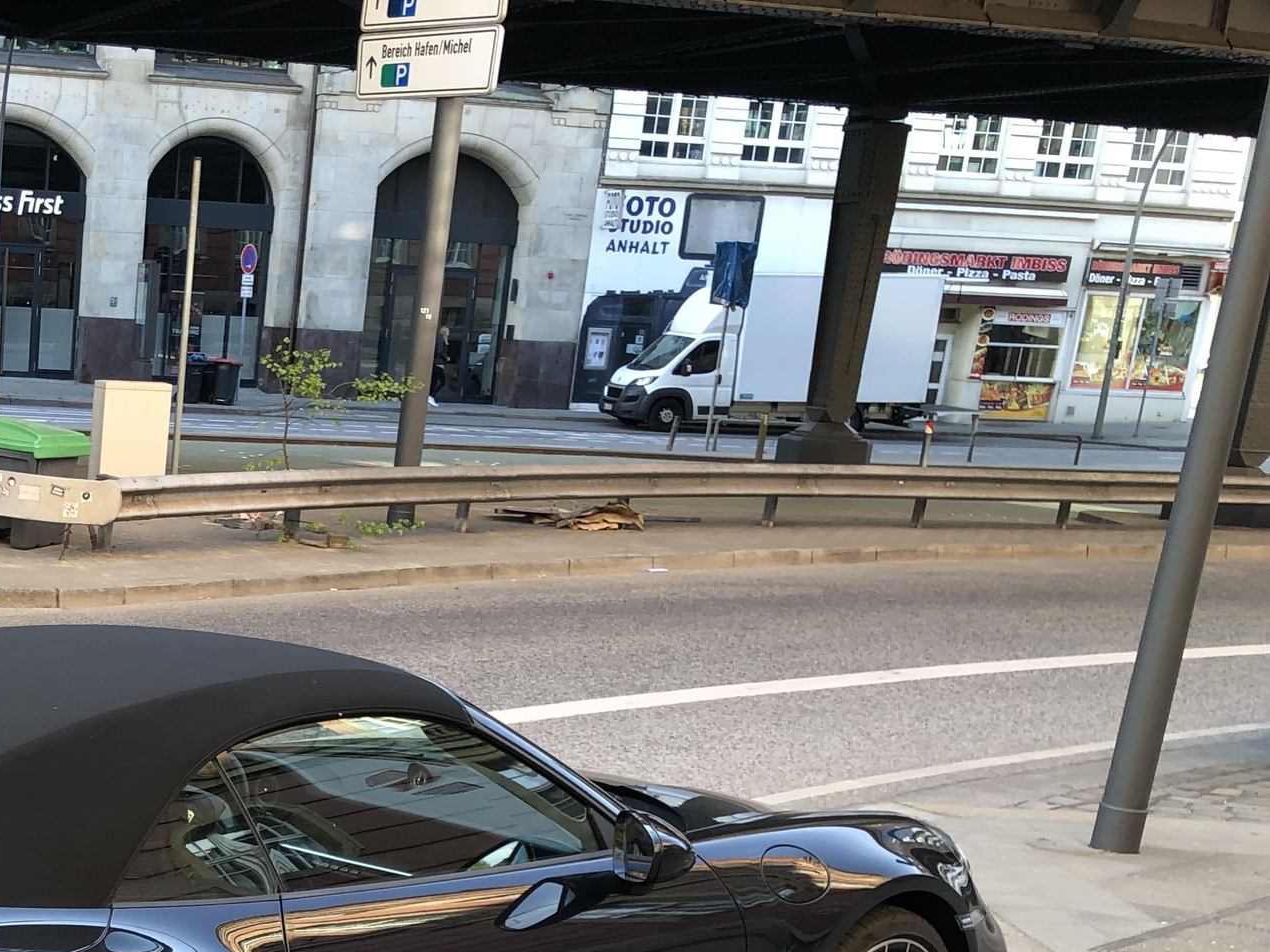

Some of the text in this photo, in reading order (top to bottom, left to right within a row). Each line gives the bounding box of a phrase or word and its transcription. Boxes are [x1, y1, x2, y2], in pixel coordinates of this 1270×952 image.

[382, 38, 472, 59] Bereich Hafen/Michel
[17, 190, 64, 216] First
[625, 196, 676, 217] OTO
[608, 218, 674, 235] TUDIO
[606, 239, 670, 255] ANHALT
[1010, 256, 1067, 272] IMBISS
[956, 267, 990, 279] Pizza
[1002, 270, 1036, 282] Pasta
[1089, 273, 1115, 284] Döner
[1127, 274, 1146, 286] izza
